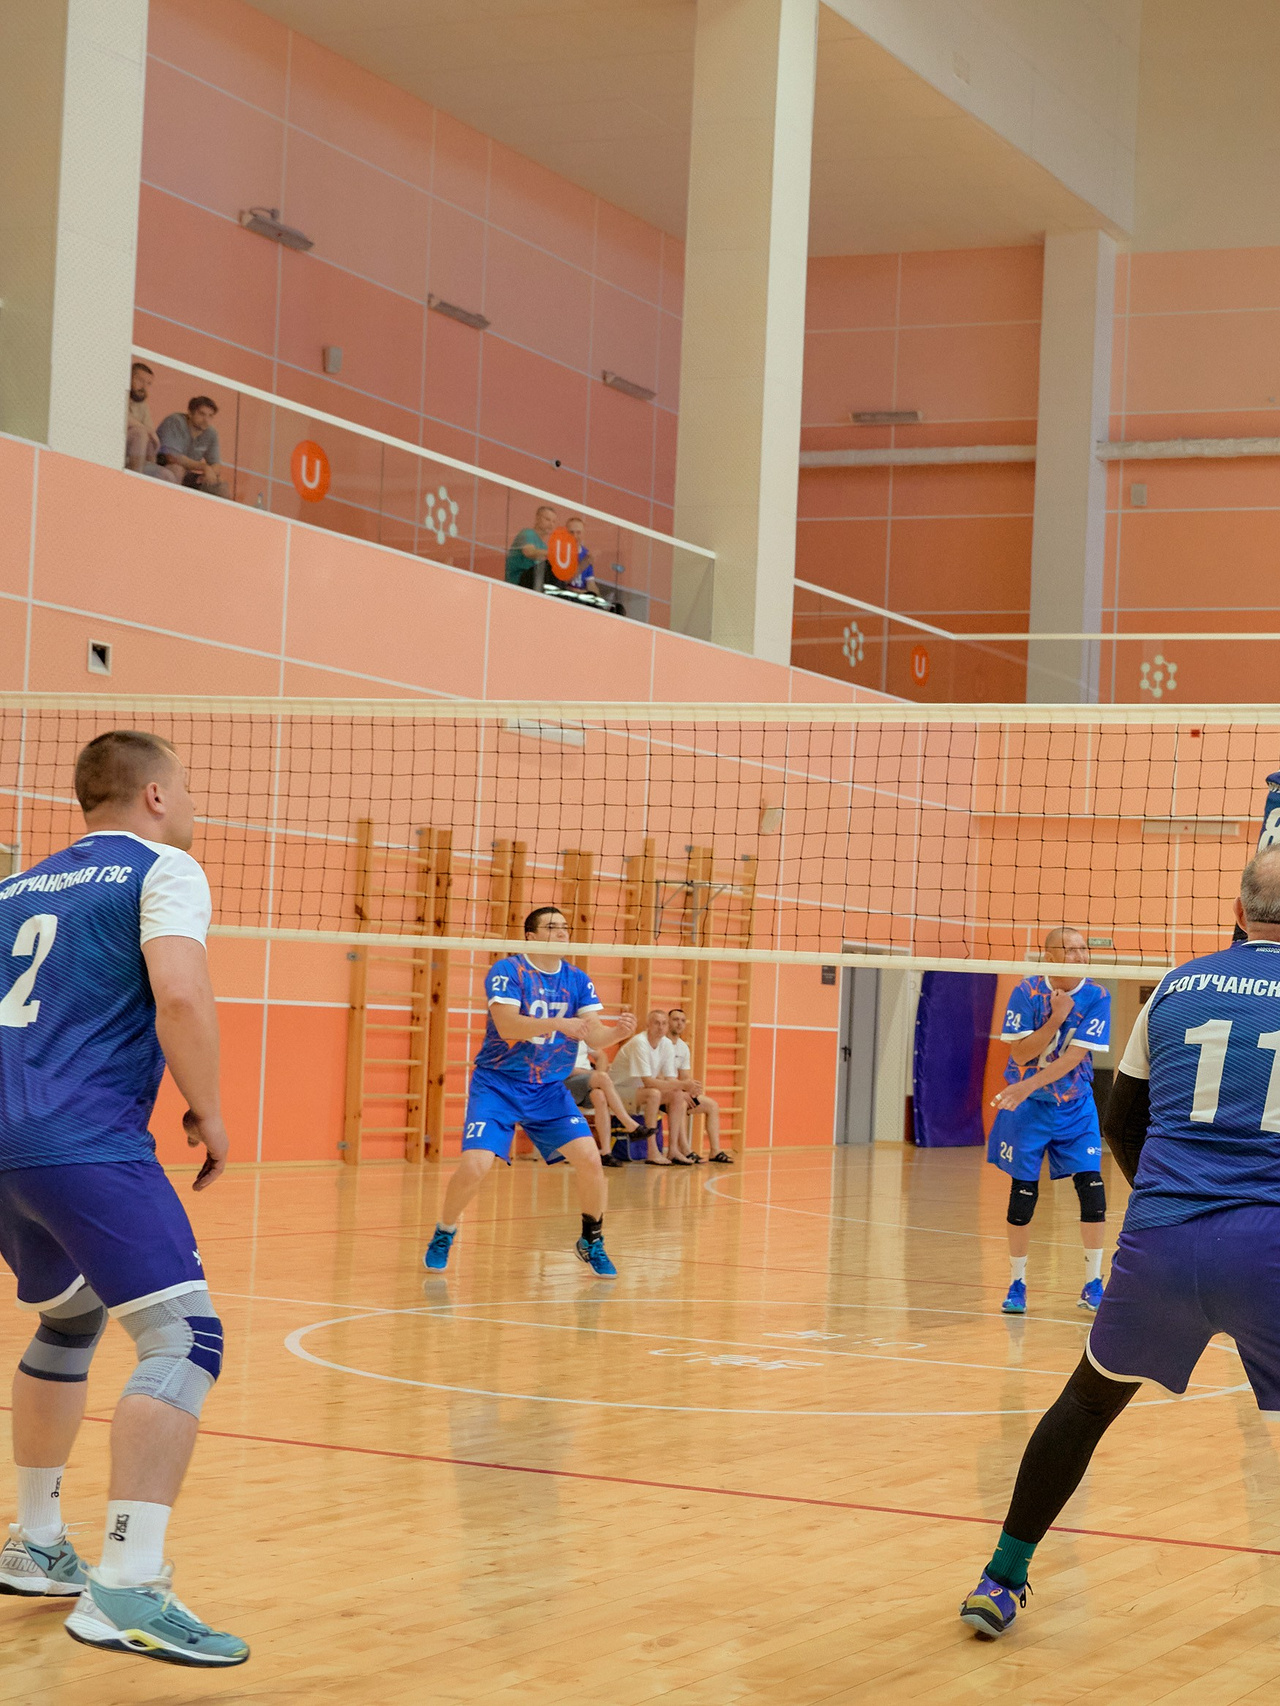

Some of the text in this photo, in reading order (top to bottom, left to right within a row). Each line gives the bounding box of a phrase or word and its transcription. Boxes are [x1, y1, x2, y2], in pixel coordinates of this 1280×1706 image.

[302, 455, 321, 490] U
[556, 539, 572, 569] U
[95, 865, 132, 884] ГЭС
[0, 914, 58, 1028] 2
[491, 975, 509, 992] 27
[587, 982, 597, 998] 2
[1006, 1010, 1021, 1030] 24
[1086, 1018, 1106, 1037] 24
[466, 1121, 486, 1139] 27
[1000, 1141, 1013, 1163] 24
